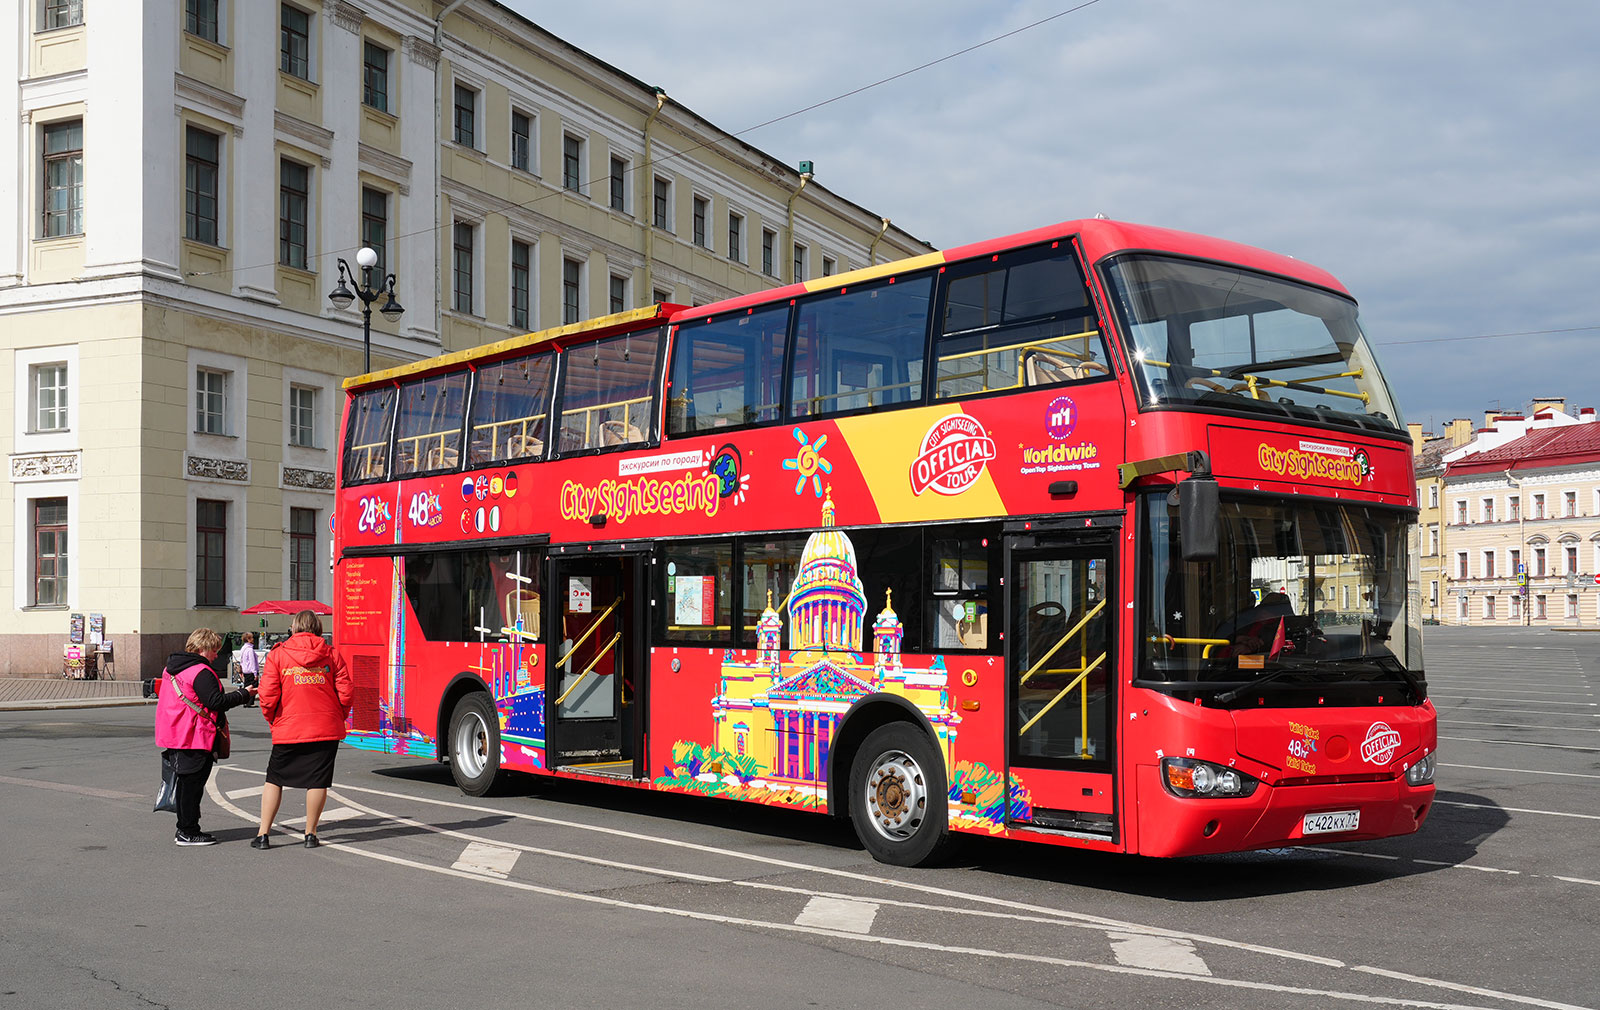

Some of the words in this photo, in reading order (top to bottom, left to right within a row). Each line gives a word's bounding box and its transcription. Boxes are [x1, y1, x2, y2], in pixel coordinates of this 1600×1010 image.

[928, 429, 941, 448] CITY
[940, 418, 978, 436] SIGHTSEEING
[620, 459, 660, 471] экскурсии
[661, 458, 671, 466] по
[672, 455, 701, 466] городу
[917, 440, 993, 484] OFFICIAL
[1023, 441, 1097, 464] Worldwide
[1258, 442, 1287, 475] City
[1286, 448, 1362, 486] Sightseeing
[946, 465, 978, 488] TOUR
[1020, 465, 1046, 475] OpenTop
[1046, 463, 1083, 473] Sightseeing
[1082, 462, 1101, 470] Tours
[560, 479, 598, 524] City
[598, 471, 720, 524] Sightseeing
[358, 496, 376, 533] 24
[408, 491, 429, 528] 48
[294, 673, 326, 686] Russia
[1365, 734, 1398, 756] OFFICIAL
[1376, 749, 1392, 762] TOUR
[1347, 812, 1357, 824] 77
